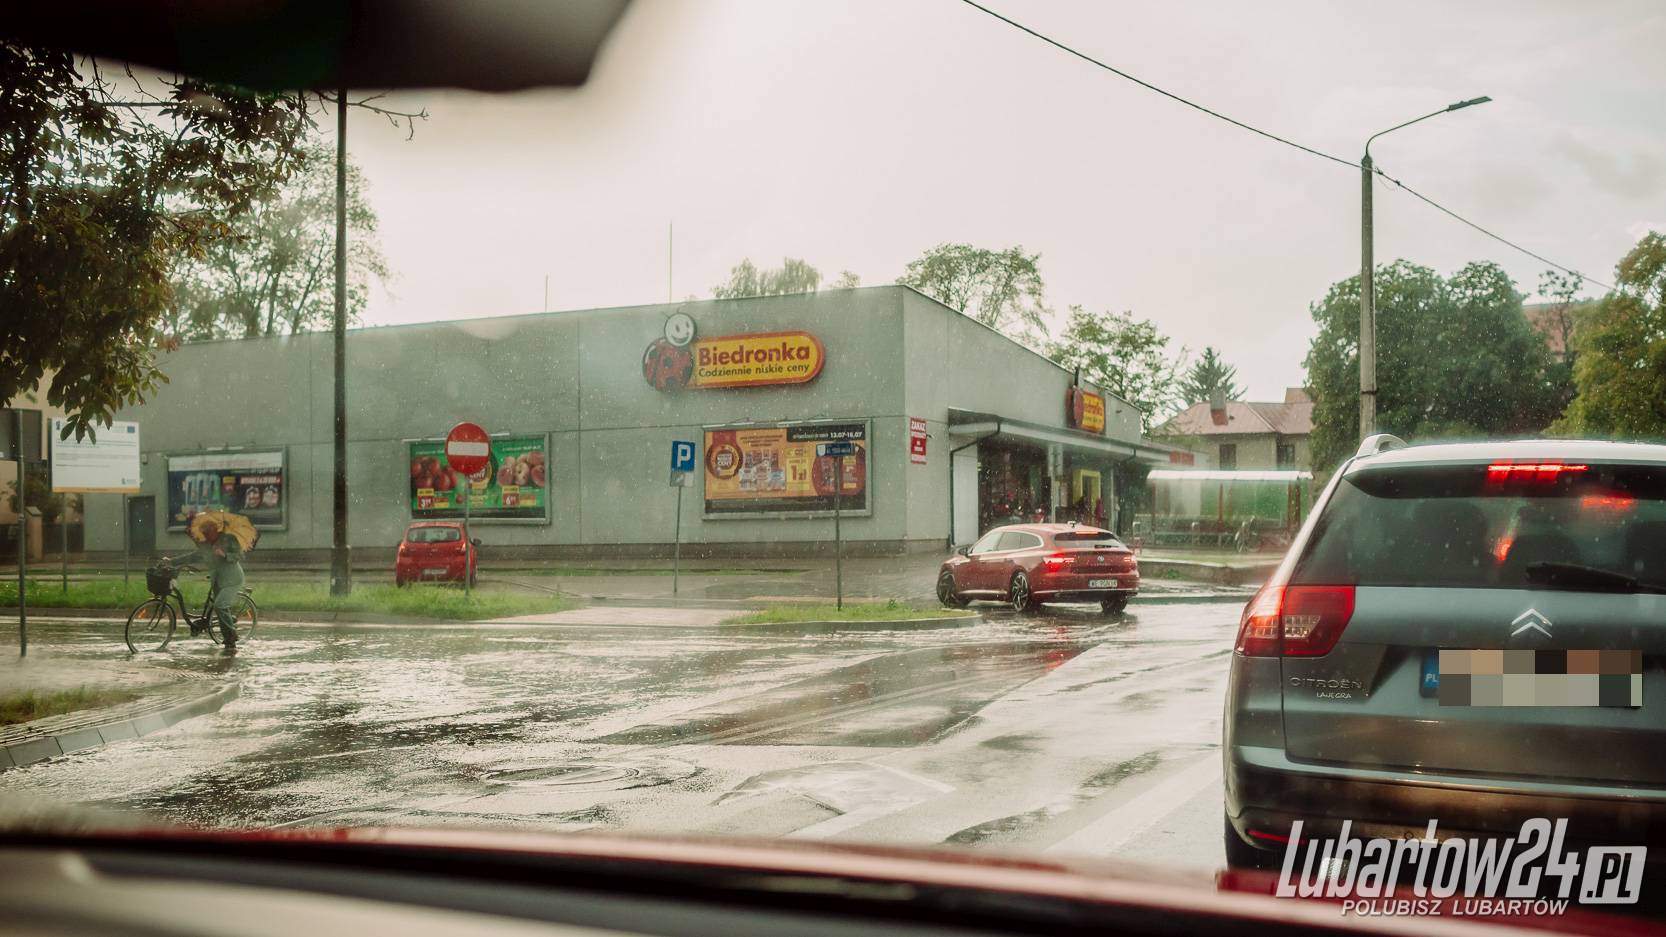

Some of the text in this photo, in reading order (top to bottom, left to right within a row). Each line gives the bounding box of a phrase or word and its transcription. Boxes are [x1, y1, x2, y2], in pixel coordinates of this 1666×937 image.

[698, 342, 810, 367] Biedronka
[698, 362, 810, 377] Codziennie niskie ceny
[677, 444, 691, 467] P
[1290, 676, 1362, 689] CITROËN
[1425, 673, 1438, 683] PL
